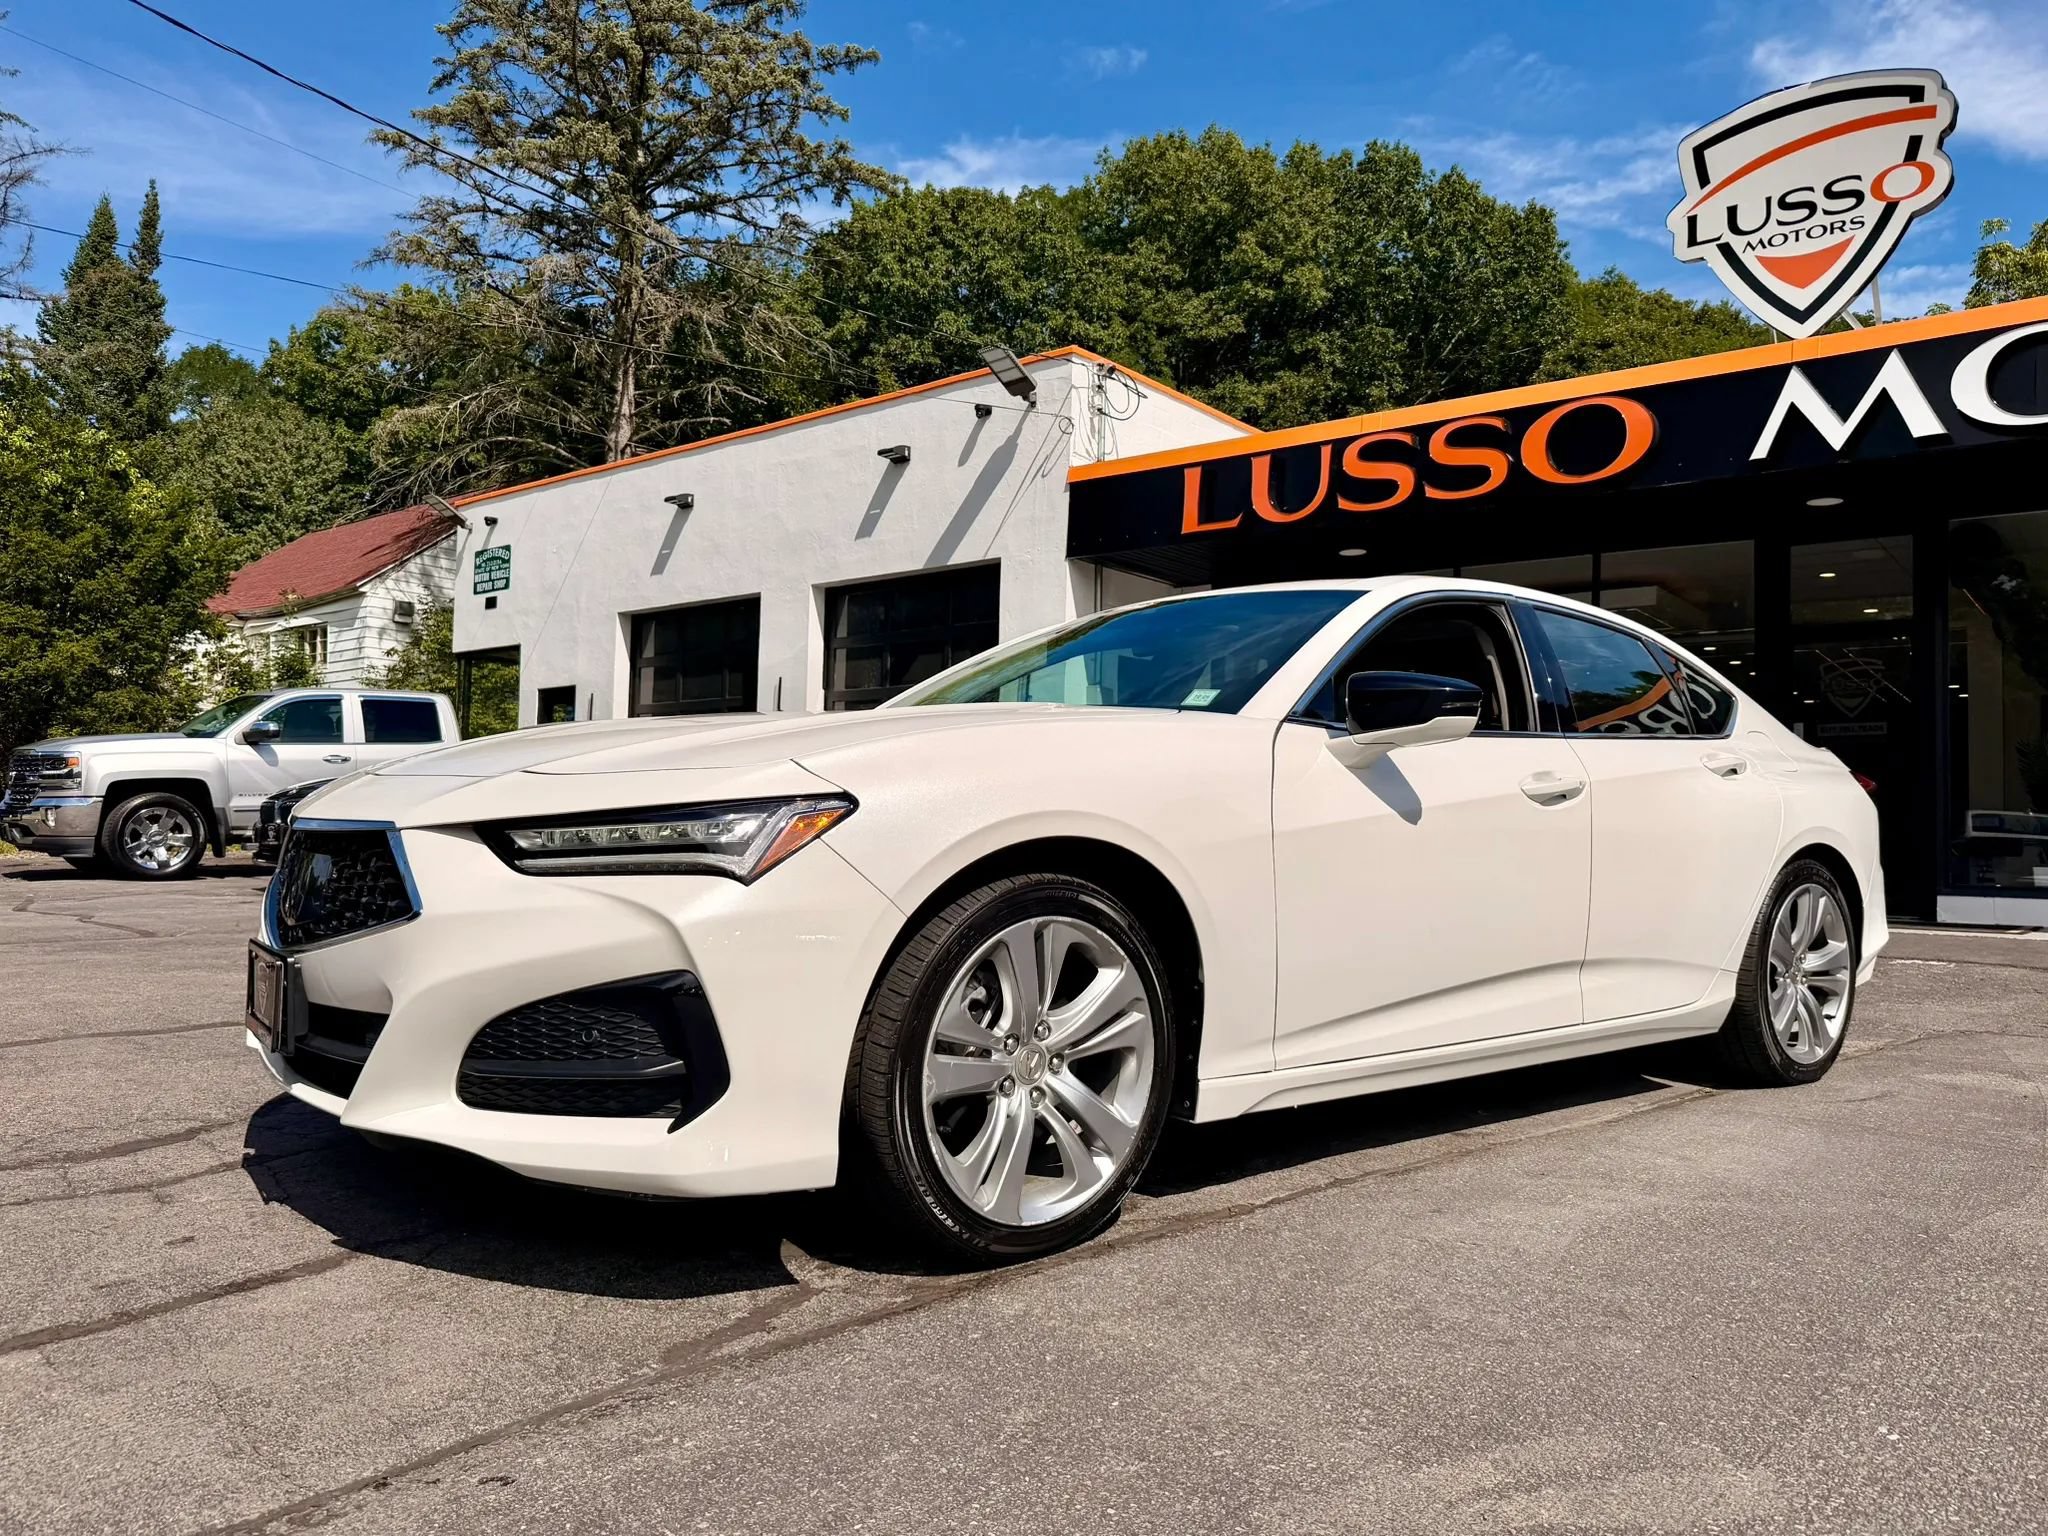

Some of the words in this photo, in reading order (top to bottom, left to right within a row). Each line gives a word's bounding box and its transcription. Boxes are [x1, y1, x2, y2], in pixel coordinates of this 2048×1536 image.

[1687, 161, 1935, 249] LUSSO
[1742, 215, 1865, 254] MOTORS
[1180, 396, 1656, 534] LUSSO
[476, 548, 510, 567] REGISTERED
[475, 573, 490, 583] MOTOR
[491, 569, 510, 580] VEHICLE
[476, 581, 493, 592] REPAIR
[494, 579, 507, 589] SHOP
